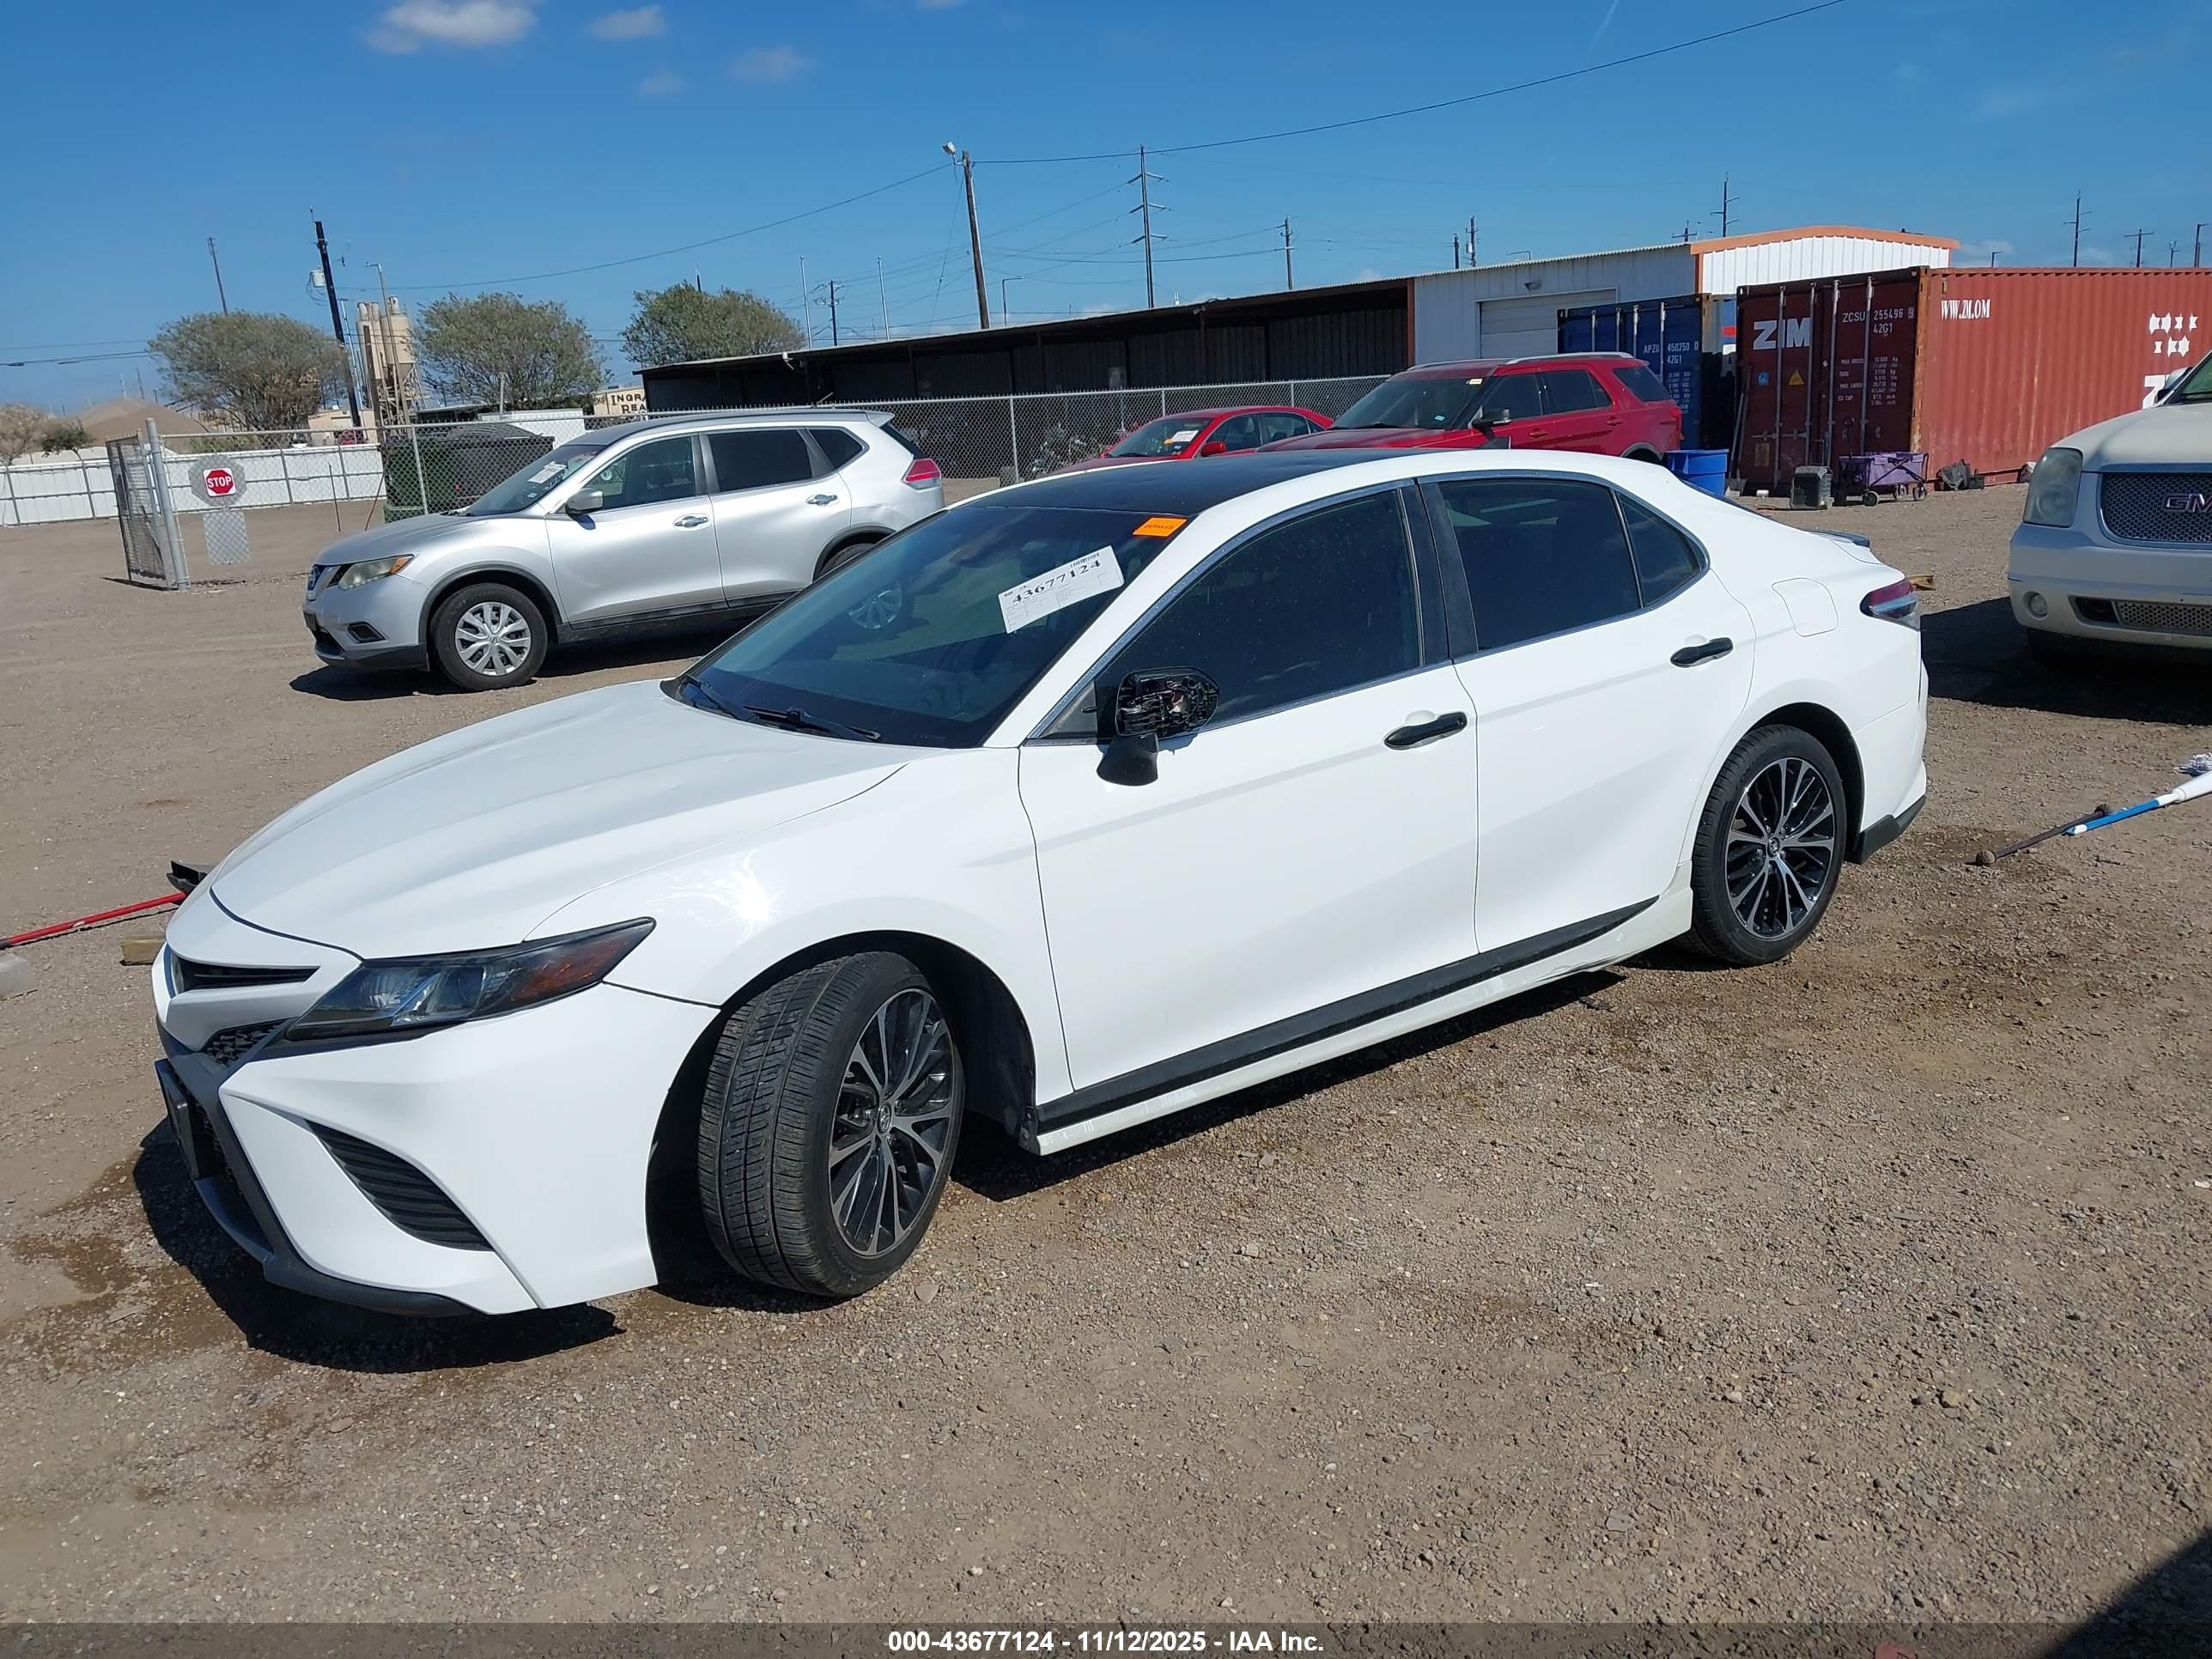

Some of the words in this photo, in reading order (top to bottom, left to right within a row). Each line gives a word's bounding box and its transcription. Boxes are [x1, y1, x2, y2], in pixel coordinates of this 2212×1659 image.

[1843, 311, 1866, 323] ZCSU
[1874, 308, 1904, 320] 255496
[1753, 318, 1813, 349] ZIM
[1873, 323, 1893, 334] 42G1
[1644, 344, 1661, 354] APZU
[1667, 355, 1682, 364] 42G1
[207, 476, 232, 488] STOP
[1012, 560, 1101, 603] 43677124
